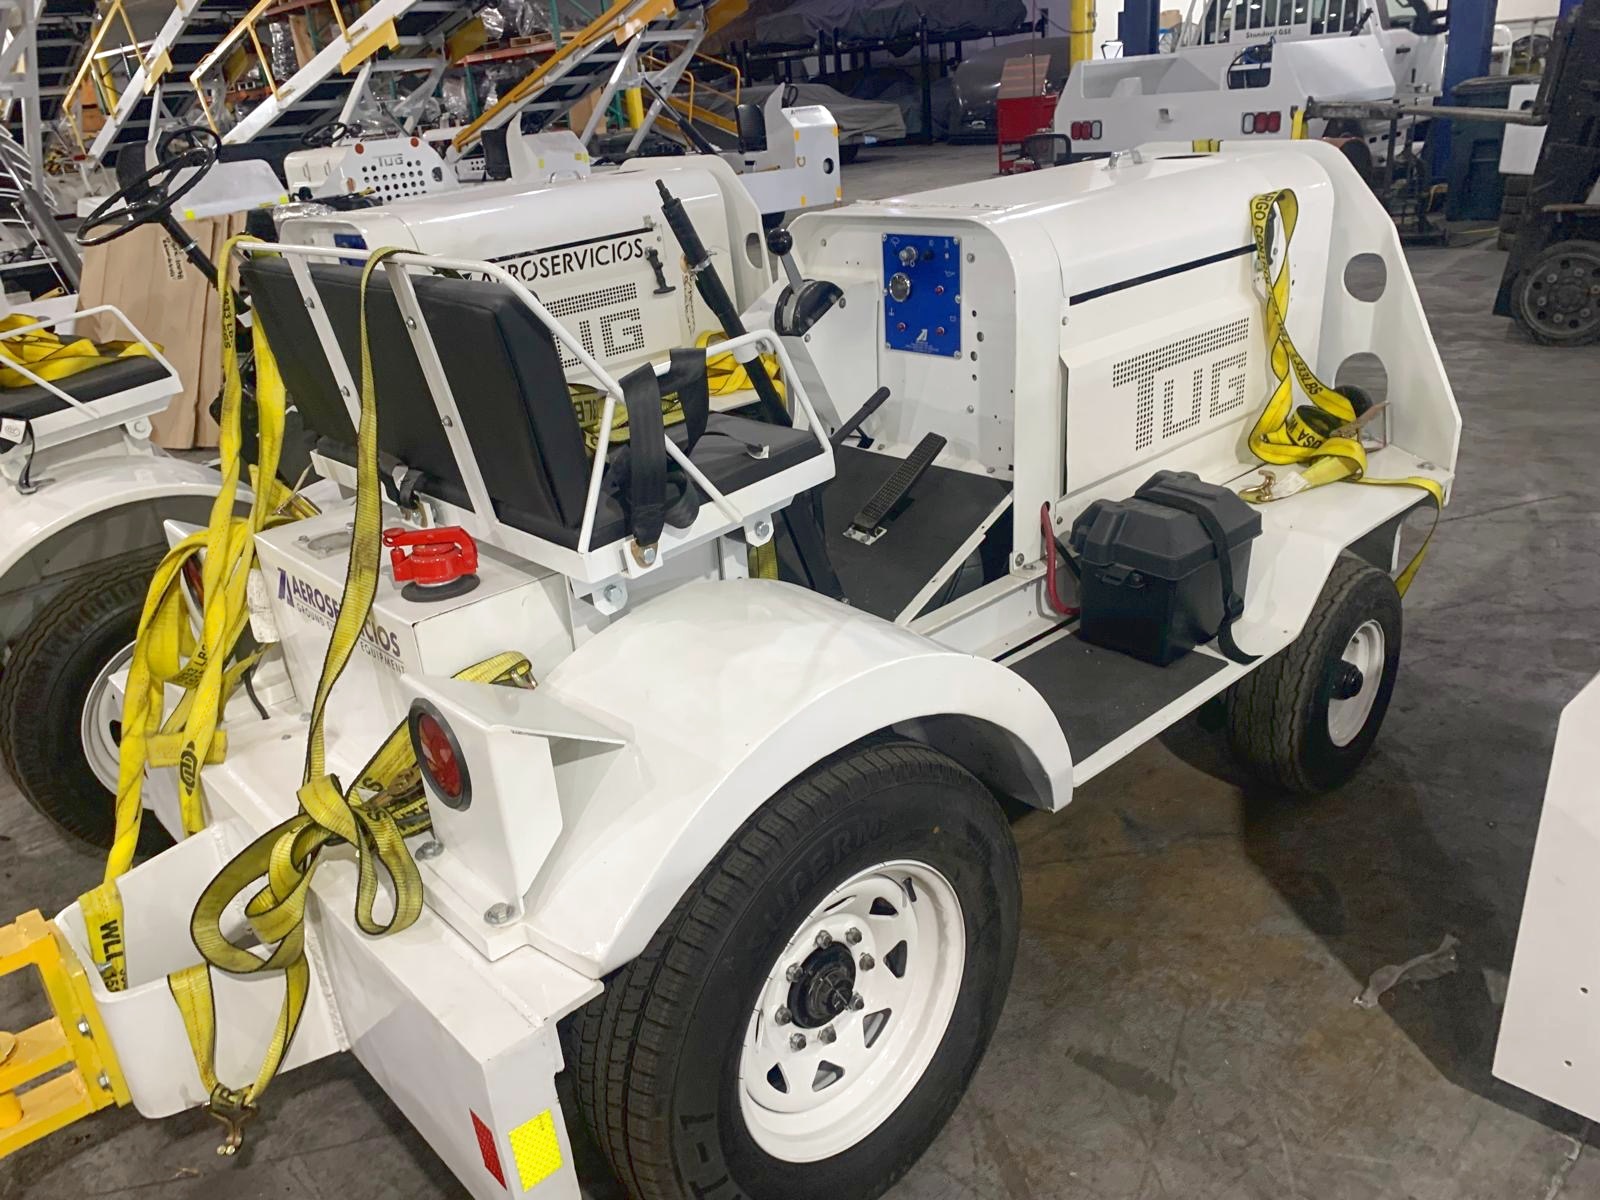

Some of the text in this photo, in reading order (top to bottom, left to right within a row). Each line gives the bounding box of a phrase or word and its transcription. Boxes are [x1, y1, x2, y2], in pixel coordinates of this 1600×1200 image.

[1246, 29, 1277, 39] Standard
[372, 153, 404, 167] TUG
[482, 237, 643, 284] AROSERVICIOS
[1112, 317, 1250, 452] TUG
[291, 575, 401, 658] AEROSECIOS
[360, 641, 406, 674] EQUIPMENT
